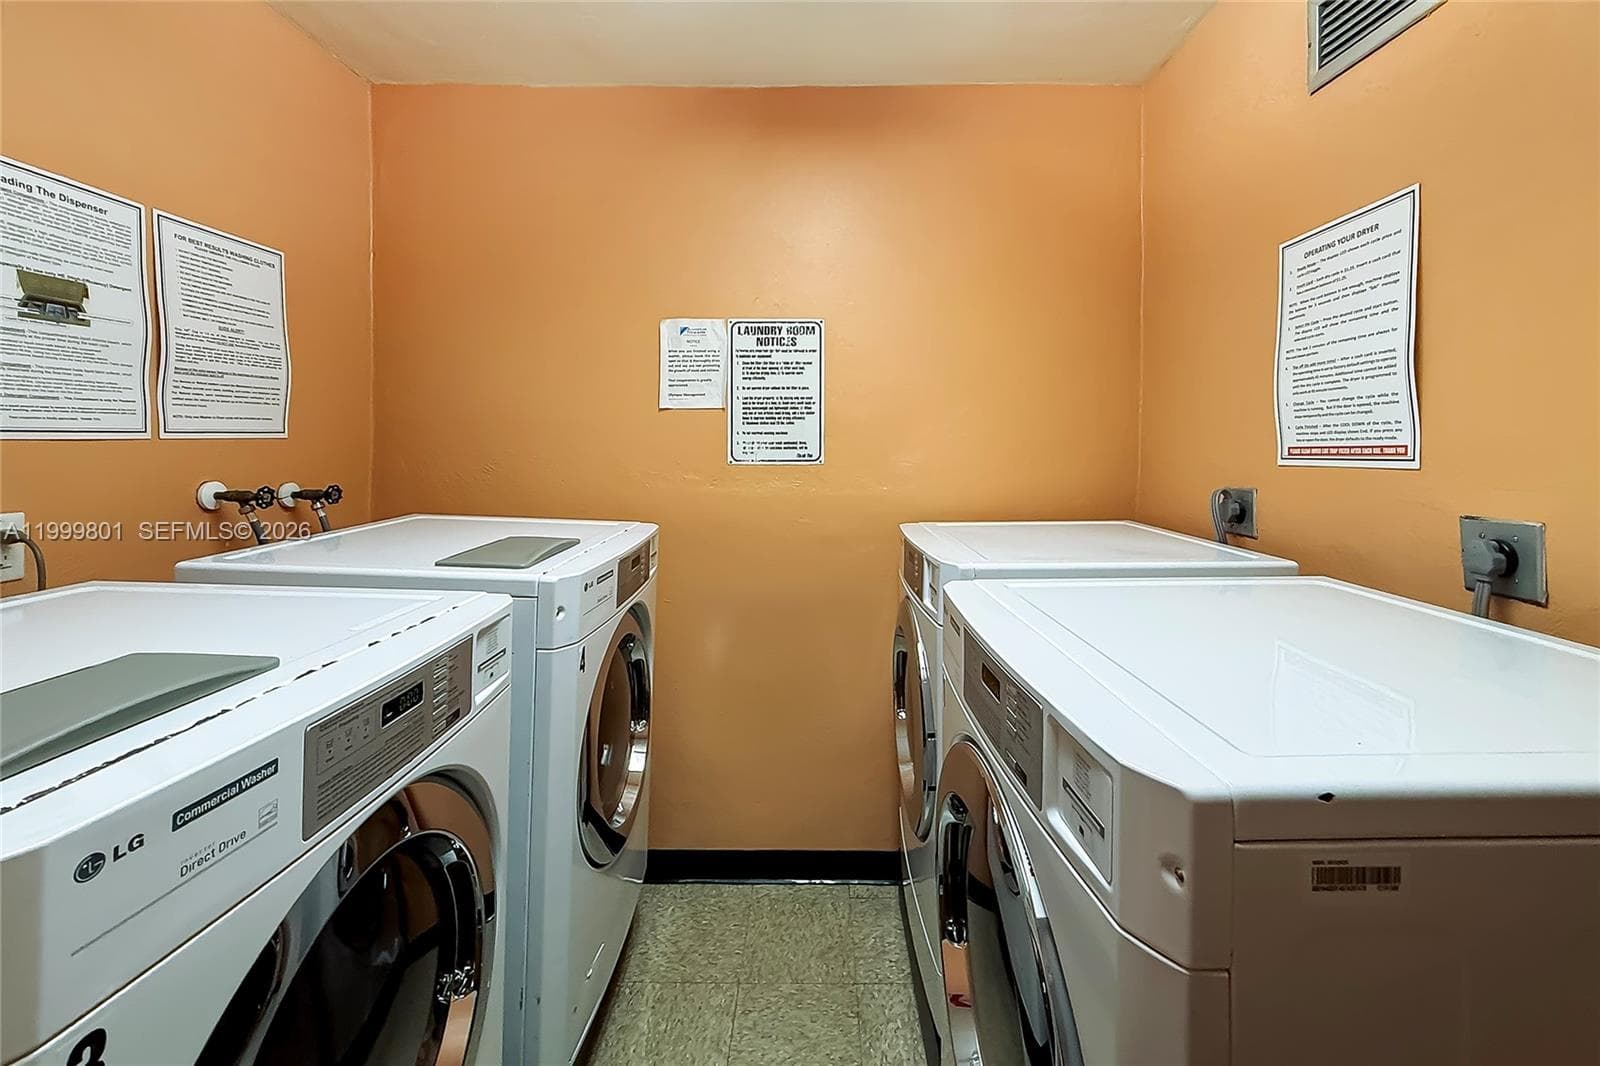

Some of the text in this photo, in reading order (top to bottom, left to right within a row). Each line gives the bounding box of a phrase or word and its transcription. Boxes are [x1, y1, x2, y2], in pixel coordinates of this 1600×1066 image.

[0, 176, 108, 215] ading The Dispenser
[174, 233, 275, 268] FOR BEST RESULTS WASHING CLOTHES
[1304, 223, 1379, 259] OPERATING YOUR DRYER
[738, 326, 815, 336] LAUNDRY ROOM
[756, 337, 797, 346] NOTICES
[176, 763, 277, 825] Commercial Washer
[113, 834, 144, 862] LG
[180, 831, 246, 877] Direct Drive
